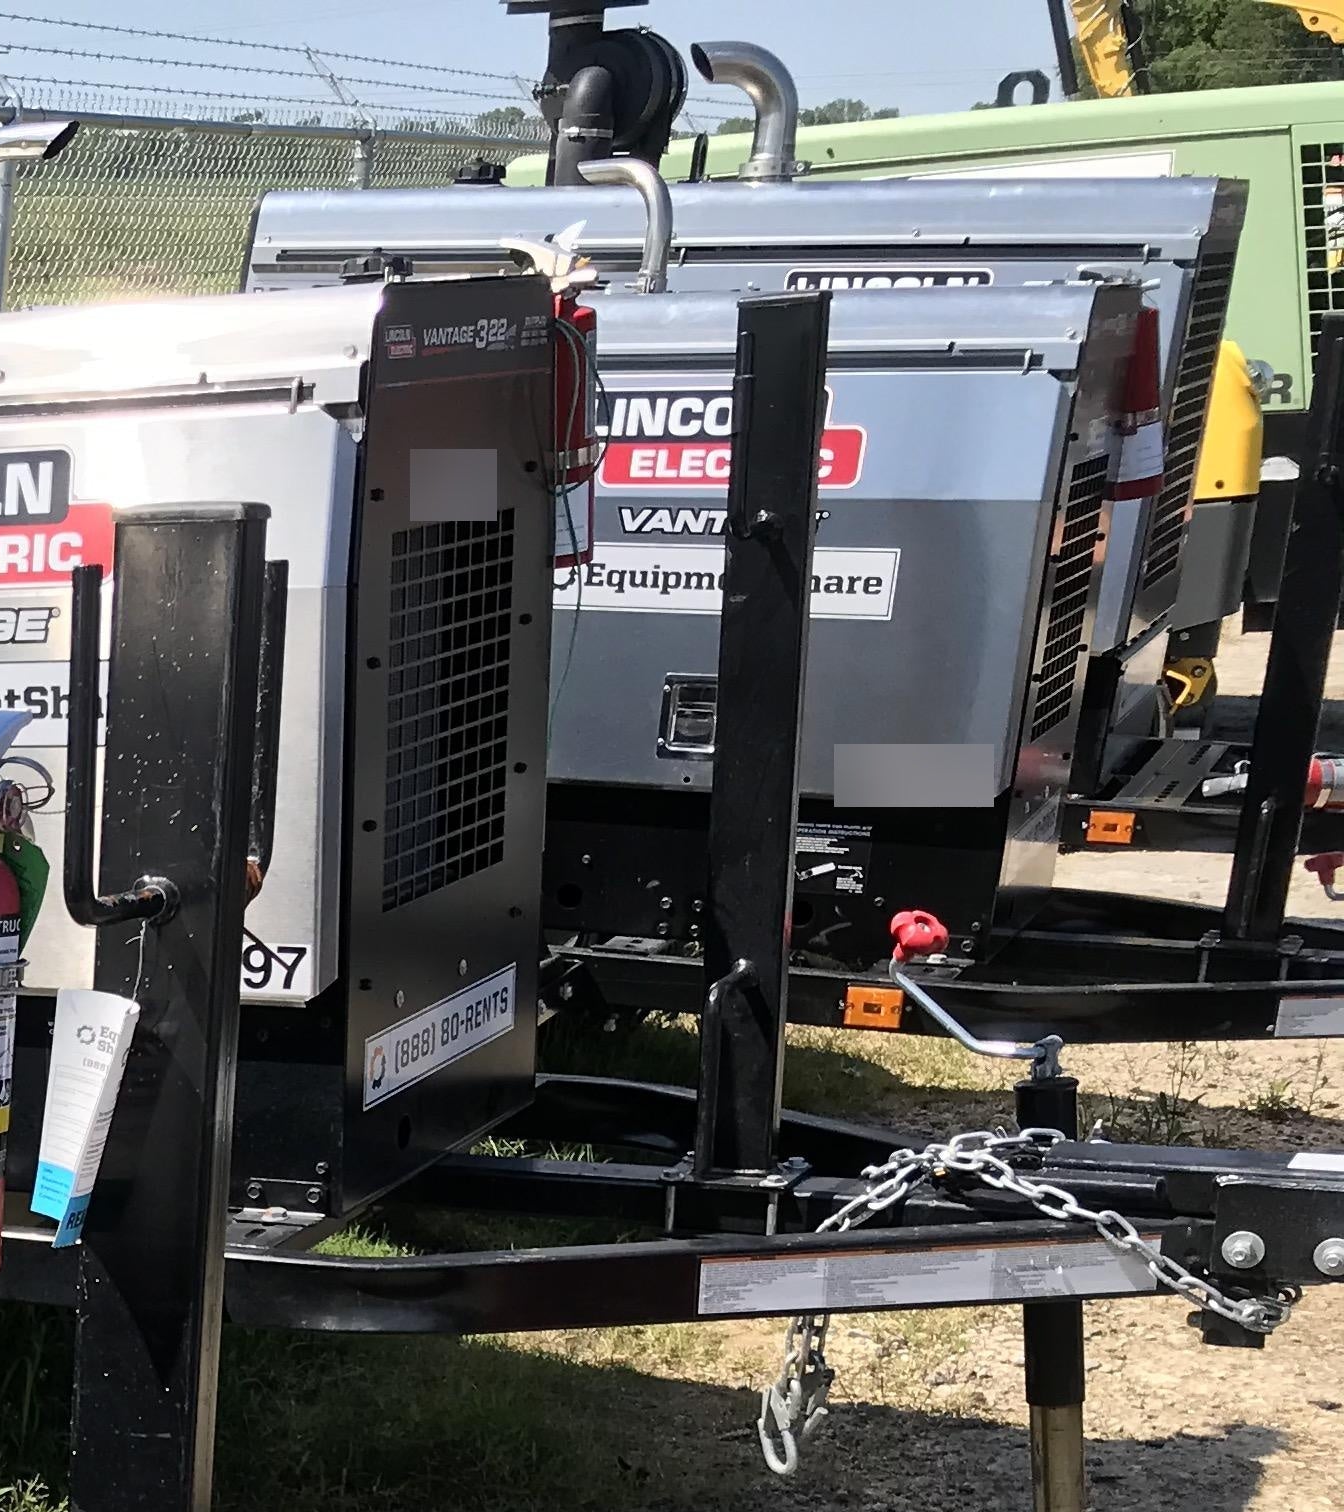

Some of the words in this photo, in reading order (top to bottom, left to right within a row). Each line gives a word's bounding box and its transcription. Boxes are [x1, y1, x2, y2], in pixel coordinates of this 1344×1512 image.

[423, 326, 475, 346] VANTAGE
[475, 318, 508, 349] 322
[595, 397, 732, 438] LINCO
[630, 449, 834, 478] ELECC
[585, 563, 883, 597] Equipmare
[394, 1025, 436, 1074] (888)
[440, 986, 509, 1047] 80-RENTS
